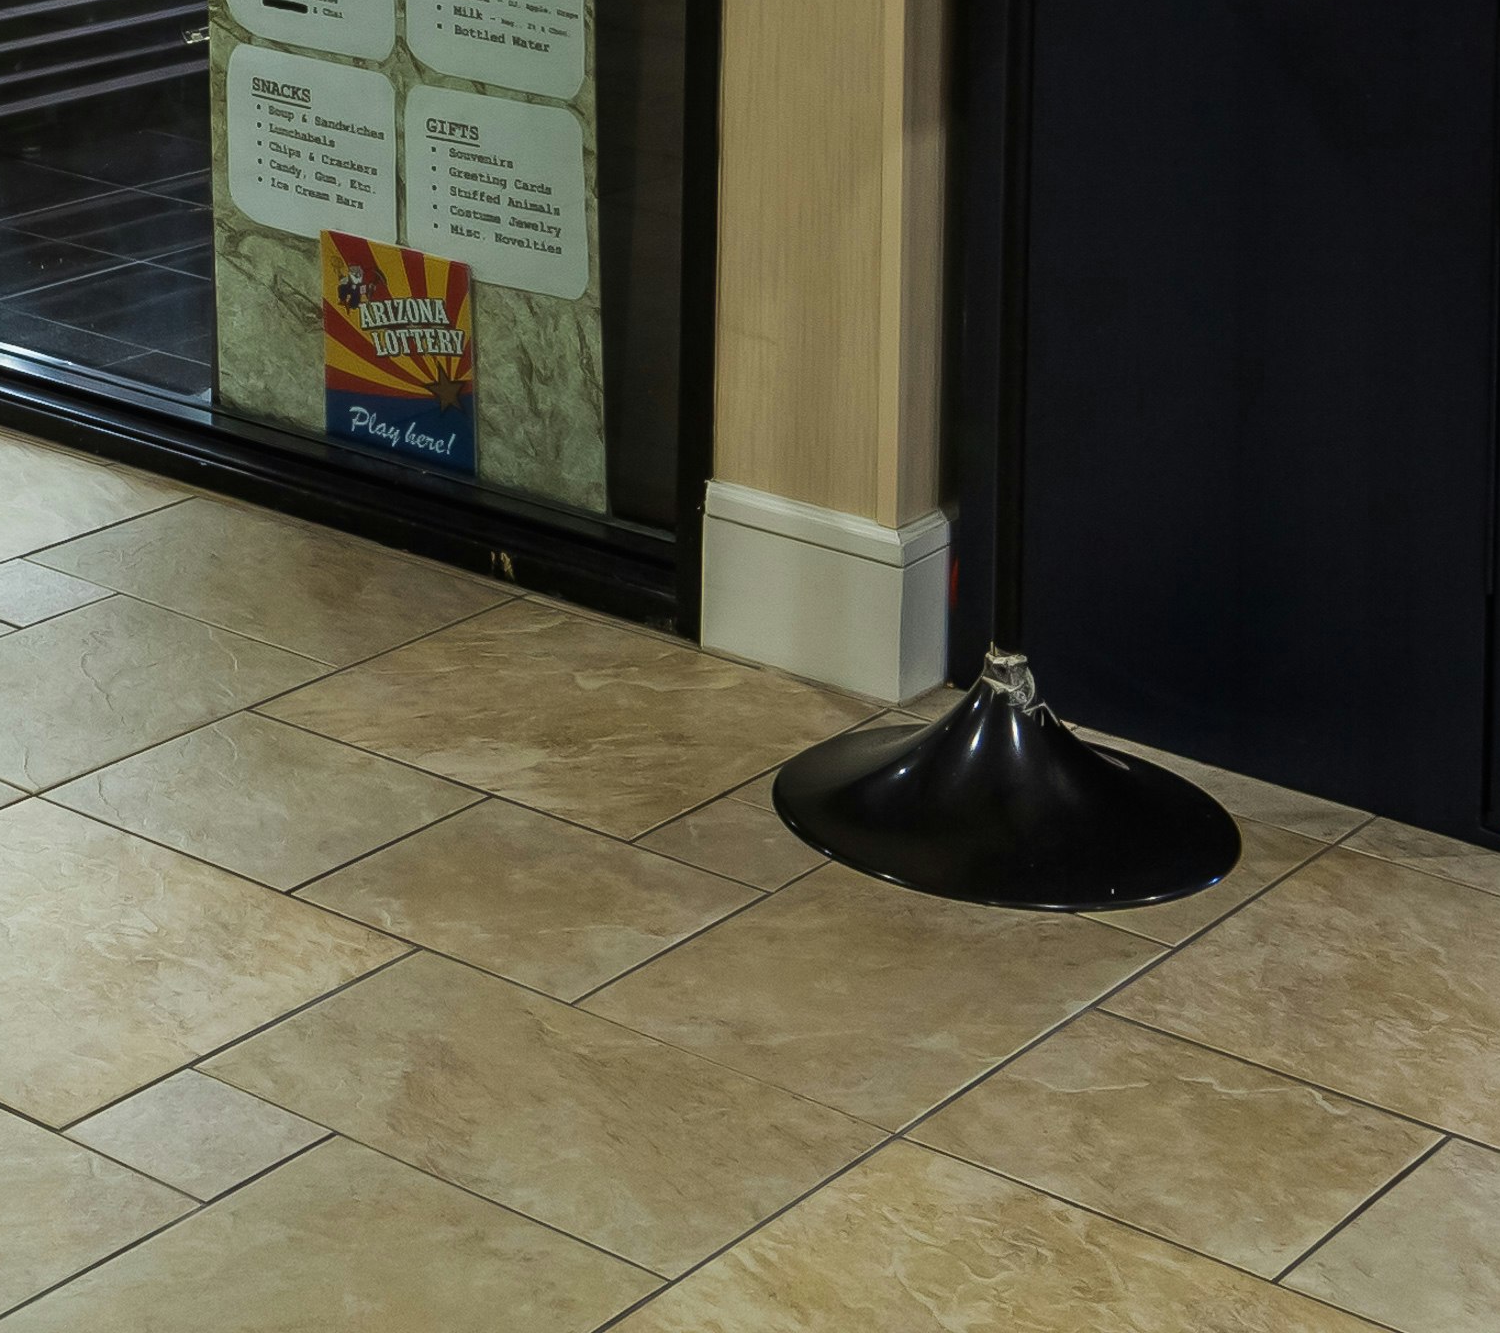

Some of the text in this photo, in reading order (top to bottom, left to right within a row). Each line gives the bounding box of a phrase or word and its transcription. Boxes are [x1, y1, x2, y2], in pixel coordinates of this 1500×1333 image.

[453, 5, 483, 20] Milk
[454, 24, 550, 53] Bottled Water
[252, 77, 311, 103] SNACKS
[269, 105, 294, 122] Soup
[315, 116, 384, 140] Sandwiches
[426, 118, 479, 140] GIFTS
[269, 141, 301, 158] Chips
[322, 154, 377, 176] Crackers
[269, 159, 306, 179] Candy,
[449, 147, 513, 169] Souvenirs
[271, 177, 364, 209] Ice Cream Bars
[449, 167, 552, 195] Greeting Cards
[449, 186, 560, 216] Stuffed Animals
[450, 205, 561, 238] Costume Jewelry
[450, 224, 562, 255] Misc. Novelties
[359, 298, 450, 329] ARIZONA
[370, 329, 466, 356] LOTTERY
[349, 407, 456, 455] Play here!
